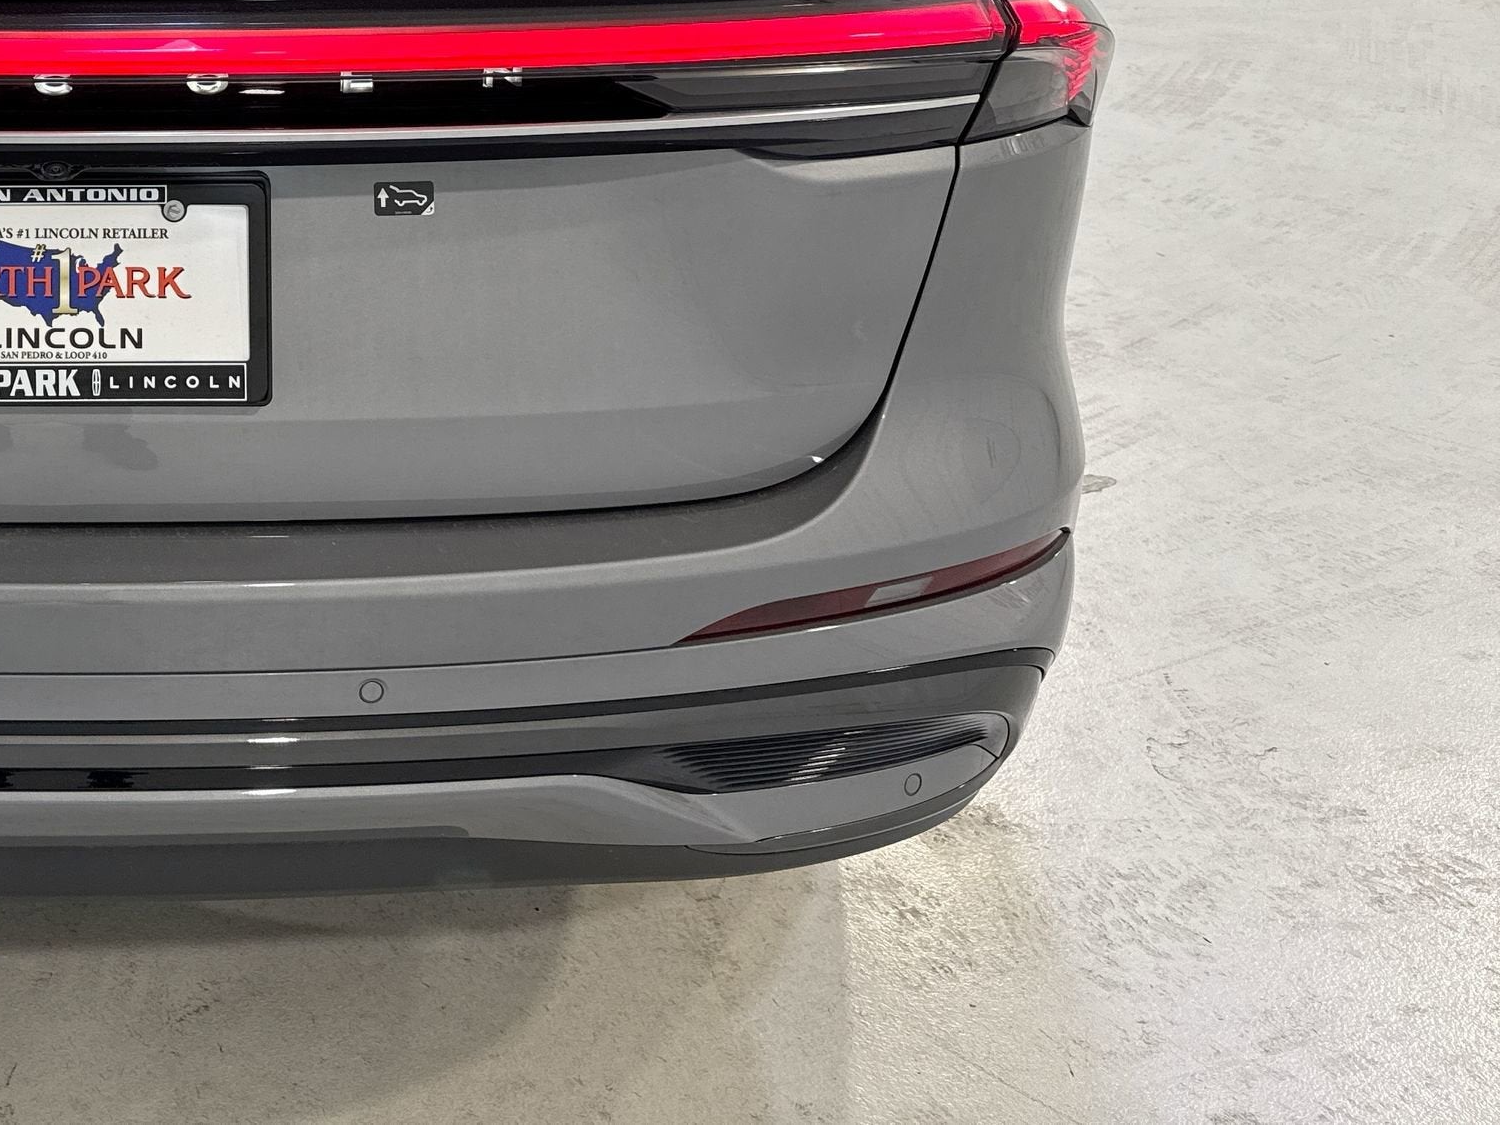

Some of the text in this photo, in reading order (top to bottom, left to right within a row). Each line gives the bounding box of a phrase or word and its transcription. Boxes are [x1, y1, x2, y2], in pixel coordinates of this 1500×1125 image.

[22, 187, 160, 203] ANTONIO
[16, 228, 30, 240] #1
[34, 227, 99, 240] LINCOLN
[102, 227, 170, 240] RETAILER
[77, 265, 192, 299] PARK
[0, 350, 108, 360] SAN PEDRO & LOOP 410
[108, 374, 242, 390] LINCOLN
